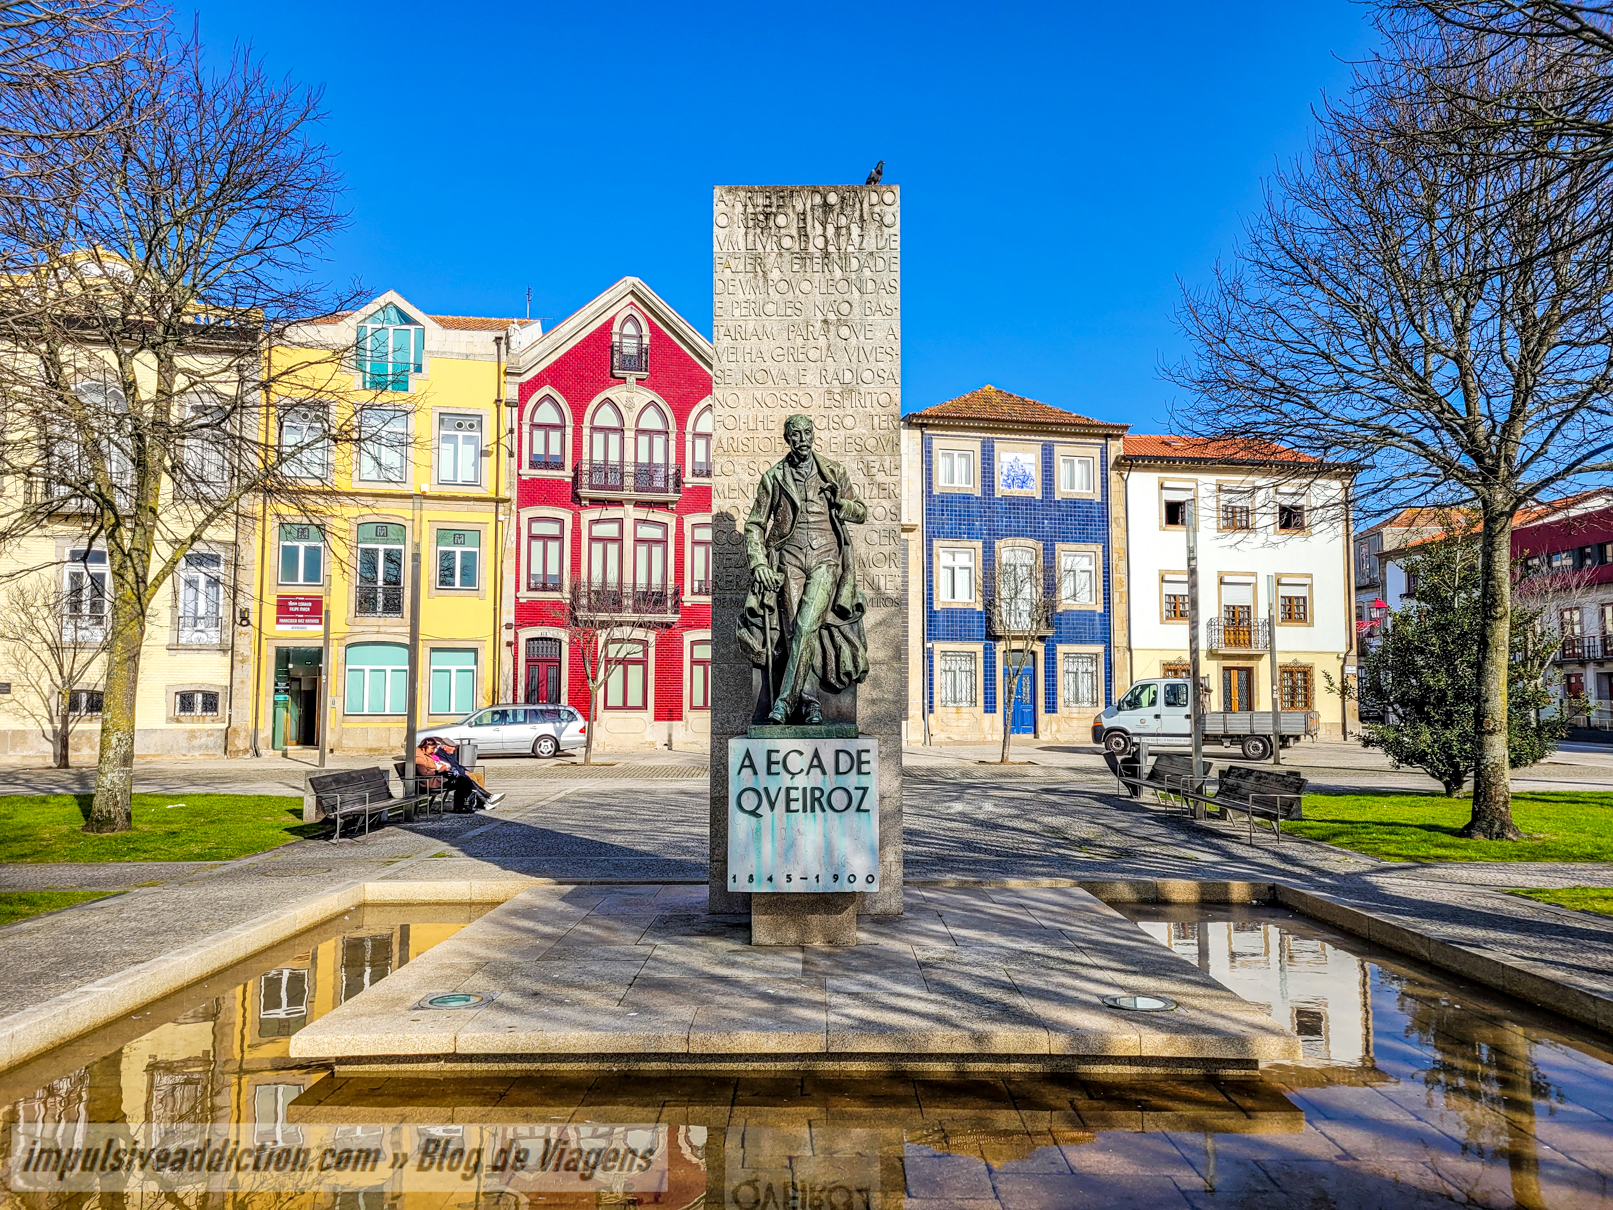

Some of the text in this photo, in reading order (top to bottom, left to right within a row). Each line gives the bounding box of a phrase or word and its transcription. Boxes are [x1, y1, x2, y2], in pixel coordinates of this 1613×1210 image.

[715, 191, 728, 206] A
[714, 212, 730, 228] O
[876, 233, 898, 250] DE
[714, 256, 898, 274] FAZER A ETERNIDADE
[714, 278, 736, 295] DE
[714, 301, 724, 317] E
[713, 324, 776, 341] TARIAM
[787, 324, 830, 341] PARA
[885, 324, 899, 340] A
[714, 346, 767, 364] VELHA
[713, 368, 899, 386] SE NOVA E RADIOSA
[713, 392, 740, 409] NO
[752, 392, 813, 409] NOSSO
[868, 413, 898, 431] TER
[829, 436, 839, 453] E
[737, 747, 872, 781] A EÇA DE
[736, 786, 872, 819] QVEIROZ
